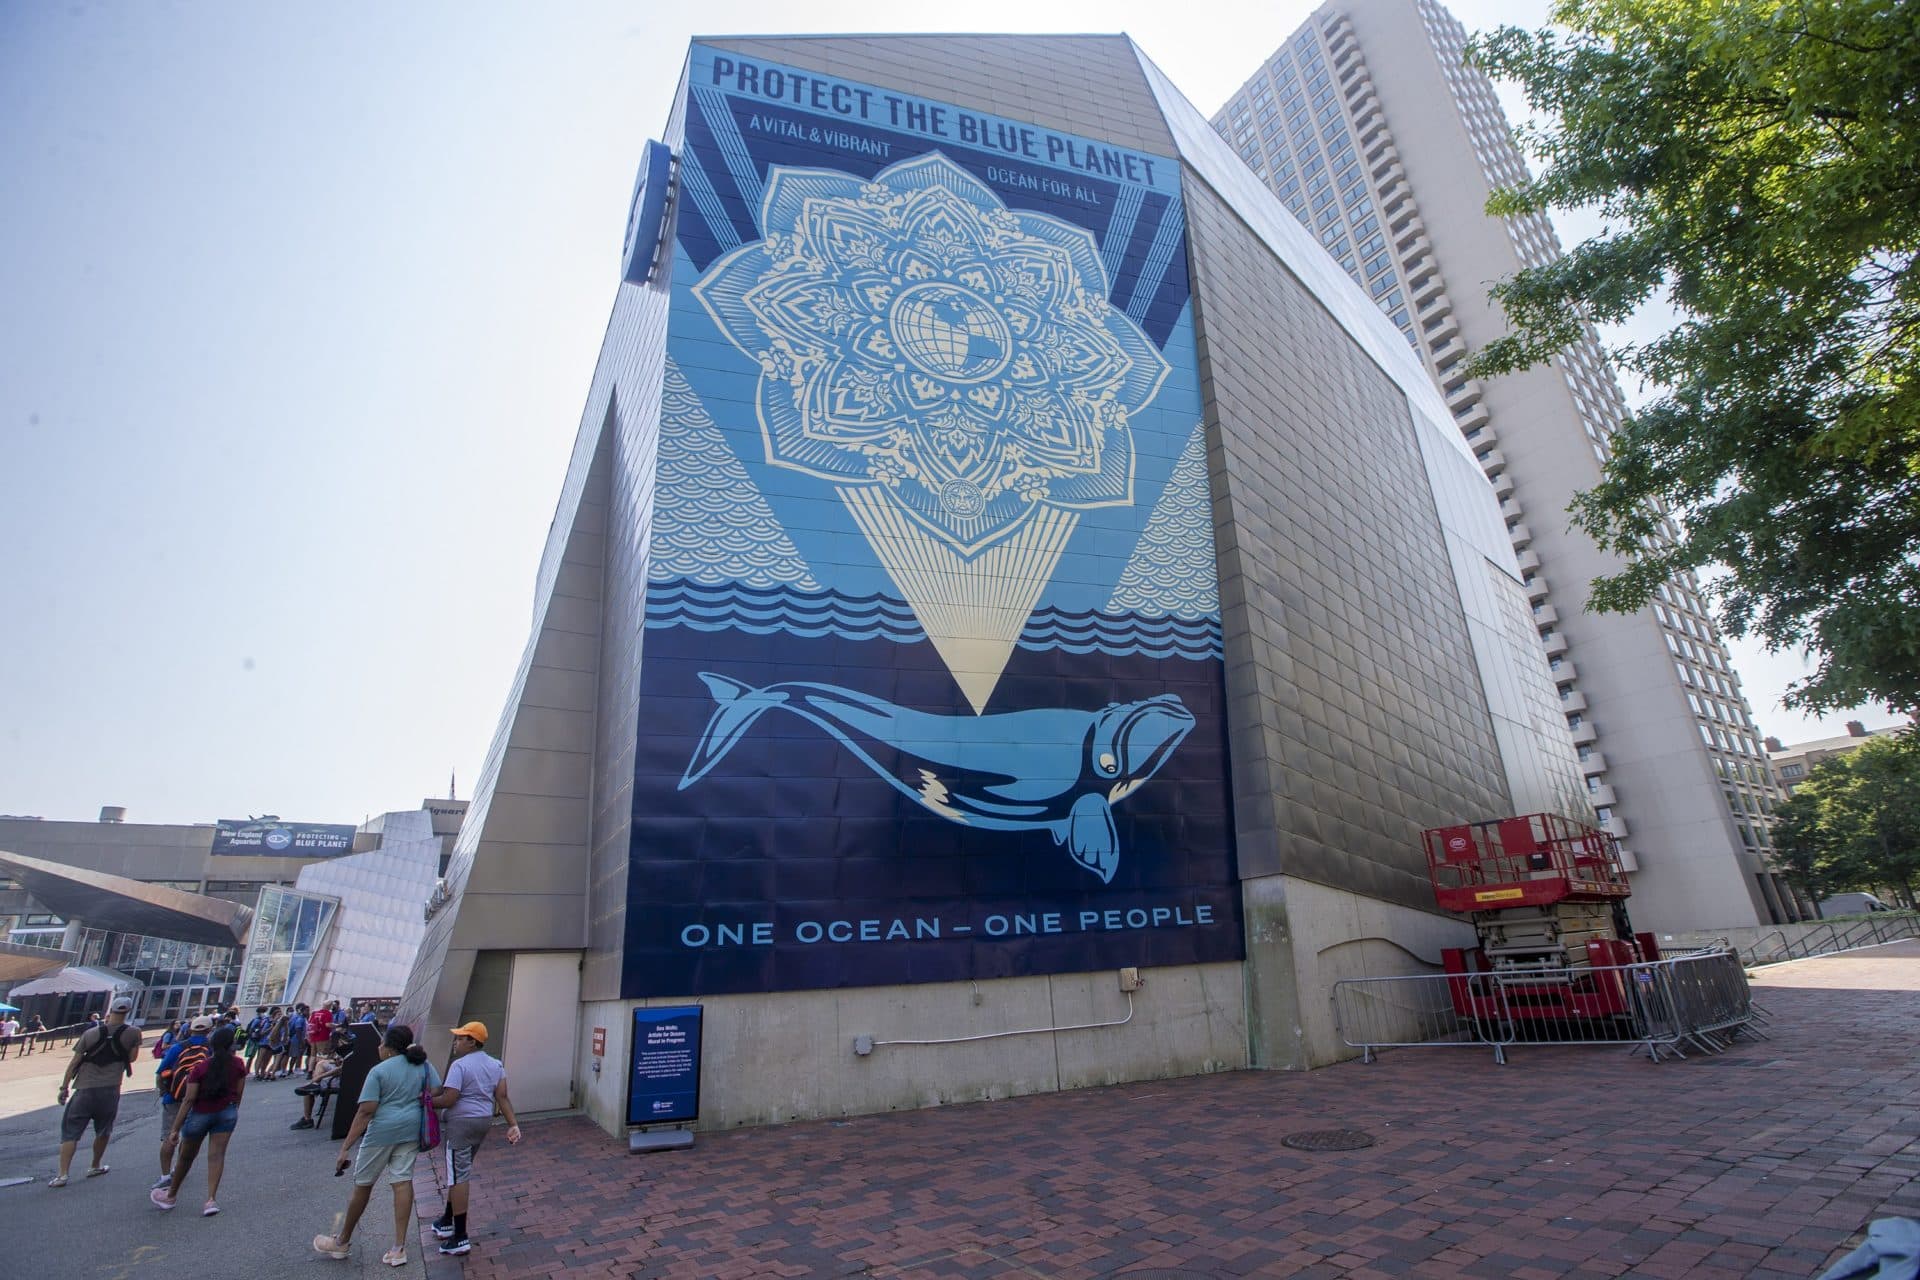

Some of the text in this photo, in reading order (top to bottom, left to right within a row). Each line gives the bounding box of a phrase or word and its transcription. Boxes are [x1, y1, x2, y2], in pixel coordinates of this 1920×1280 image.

[711, 55, 1155, 186] PROTECT THE BLUE PLANET
[749, 114, 892, 158] A VITAL & VIBRANT
[987, 165, 1102, 205] OCEAN FOR ALL
[230, 837, 262, 846] Aquarium
[237, 830, 263, 839] England
[295, 839, 348, 848] BLUE PLANET
[296, 833, 340, 841] PROTECTING
[681, 922, 774, 947] ONE
[796, 917, 941, 944] OCEAN
[984, 912, 1063, 936] ONE
[1079, 905, 1215, 931] PEOPLE
